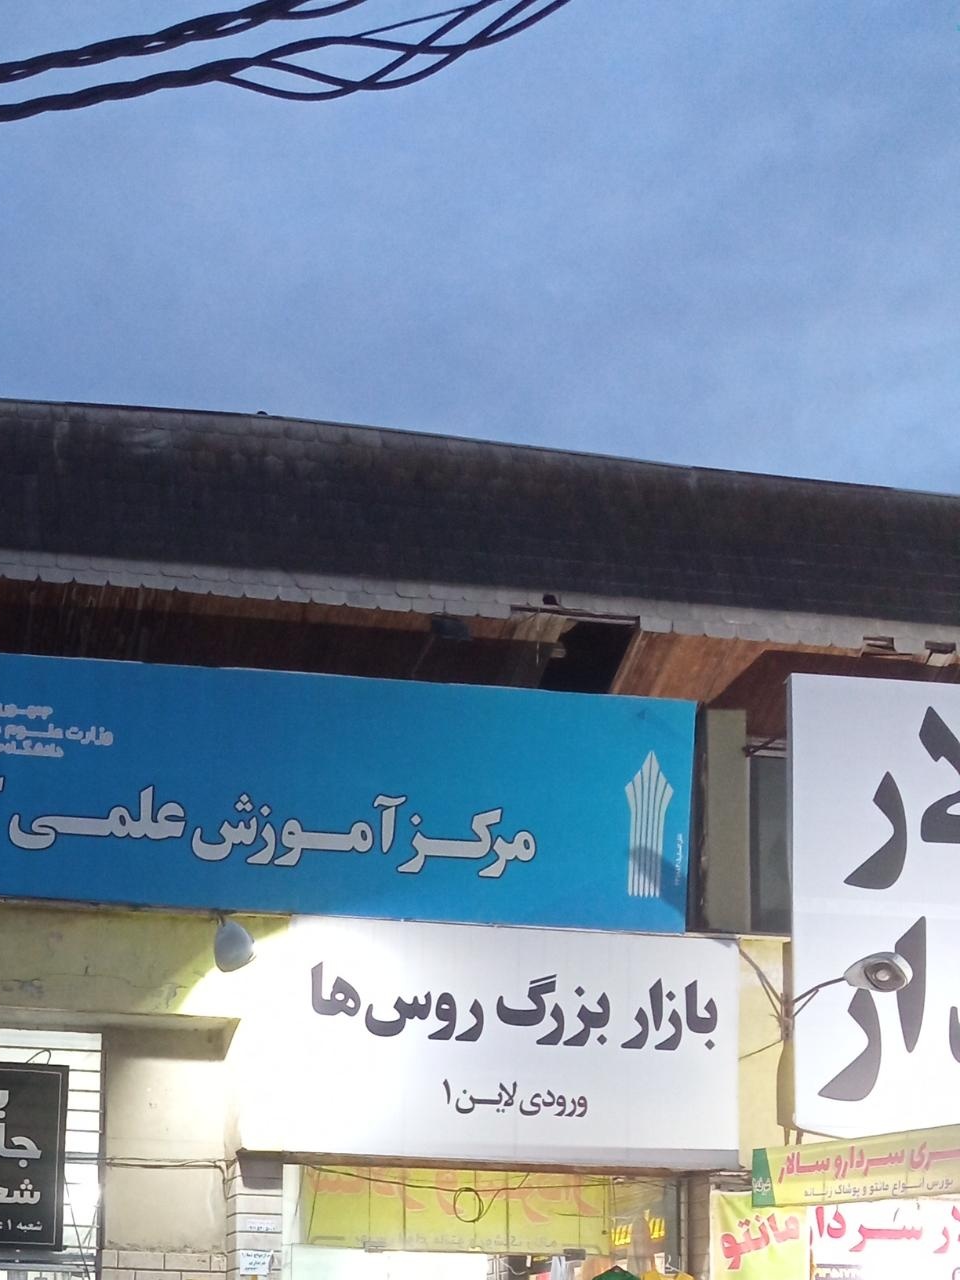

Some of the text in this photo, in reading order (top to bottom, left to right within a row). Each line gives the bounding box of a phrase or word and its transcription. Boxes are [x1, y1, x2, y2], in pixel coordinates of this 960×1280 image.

[65, 725, 114, 746] وزارت
[8, 785, 187, 850] علمی
[191, 793, 407, 866] آموزش
[396, 807, 536, 878] مرکز
[497, 974, 610, 1047] بزرگ
[621, 978, 718, 1050] بازار
[443, 1079, 588, 1117] ورودی لاین ۱
[778, 1151, 830, 1184] سالار
[16, 1221, 43, 1233] شعبه
[720, 1213, 800, 1270] مانتو
